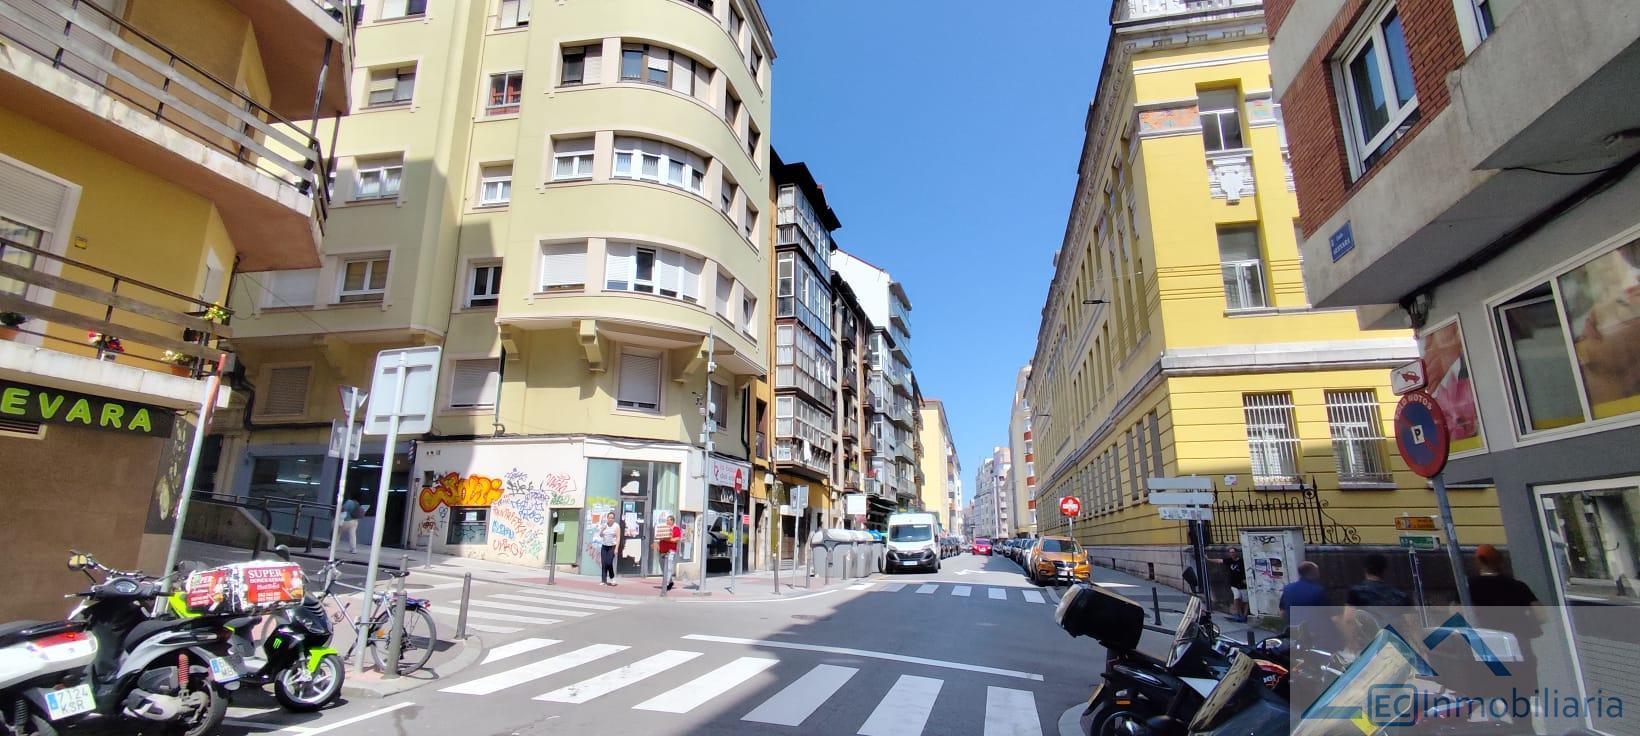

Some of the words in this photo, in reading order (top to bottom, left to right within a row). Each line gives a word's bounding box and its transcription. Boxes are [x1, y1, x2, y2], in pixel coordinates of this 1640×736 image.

[1, 387, 152, 432] EVARA
[1408, 394, 1433, 411] MOTOS
[1414, 428, 1421, 441] P
[248, 568, 281, 579] SUPER
